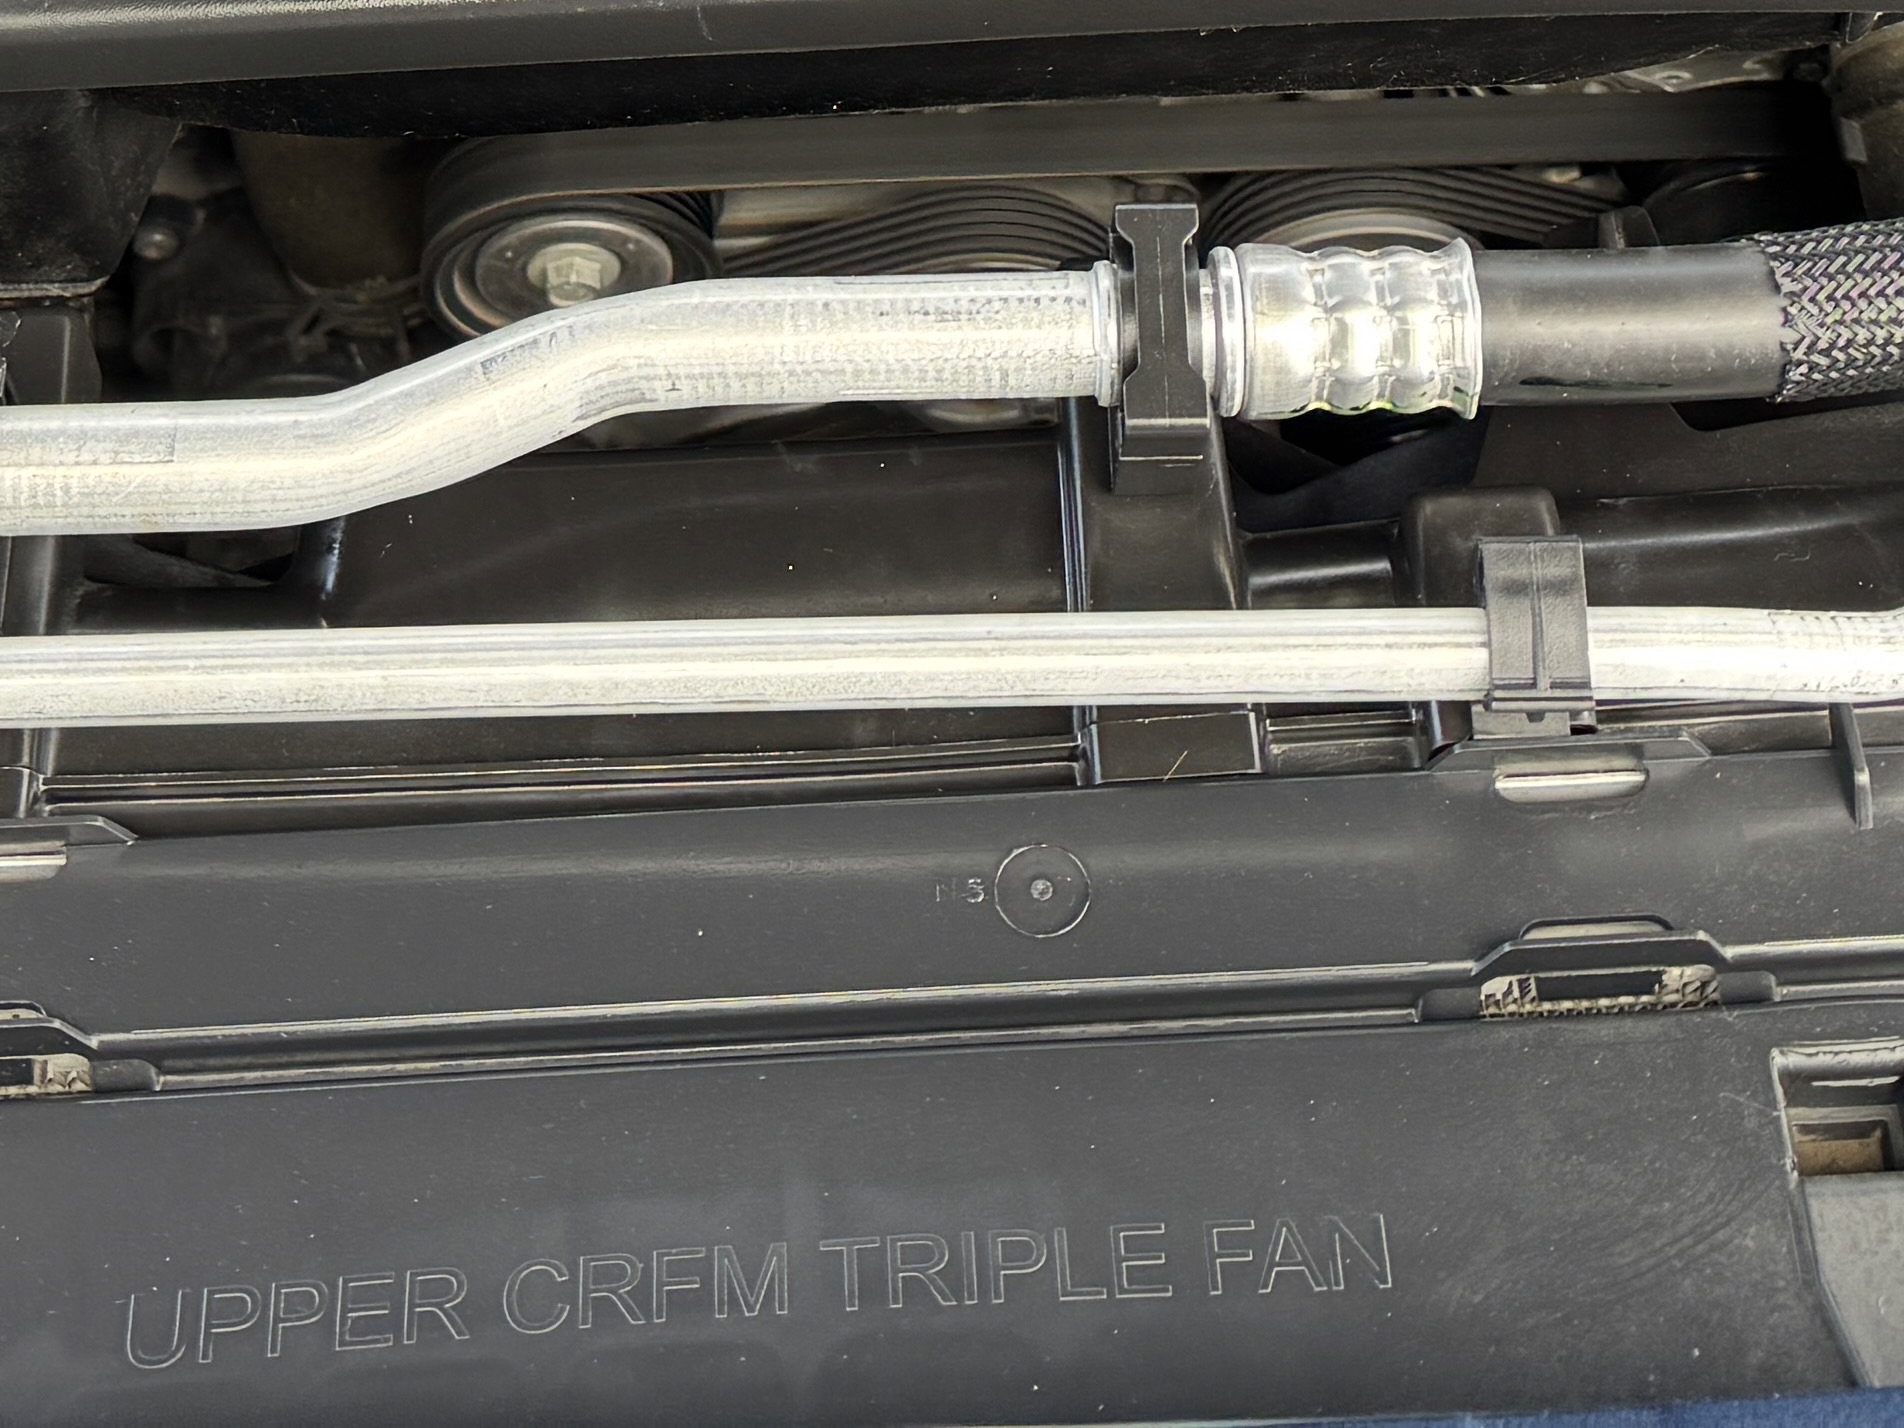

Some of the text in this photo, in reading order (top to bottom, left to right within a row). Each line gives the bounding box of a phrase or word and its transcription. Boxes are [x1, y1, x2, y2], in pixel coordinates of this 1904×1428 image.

[118, 1212, 1396, 1371] UPPER CRFM TRIPLE FAN
